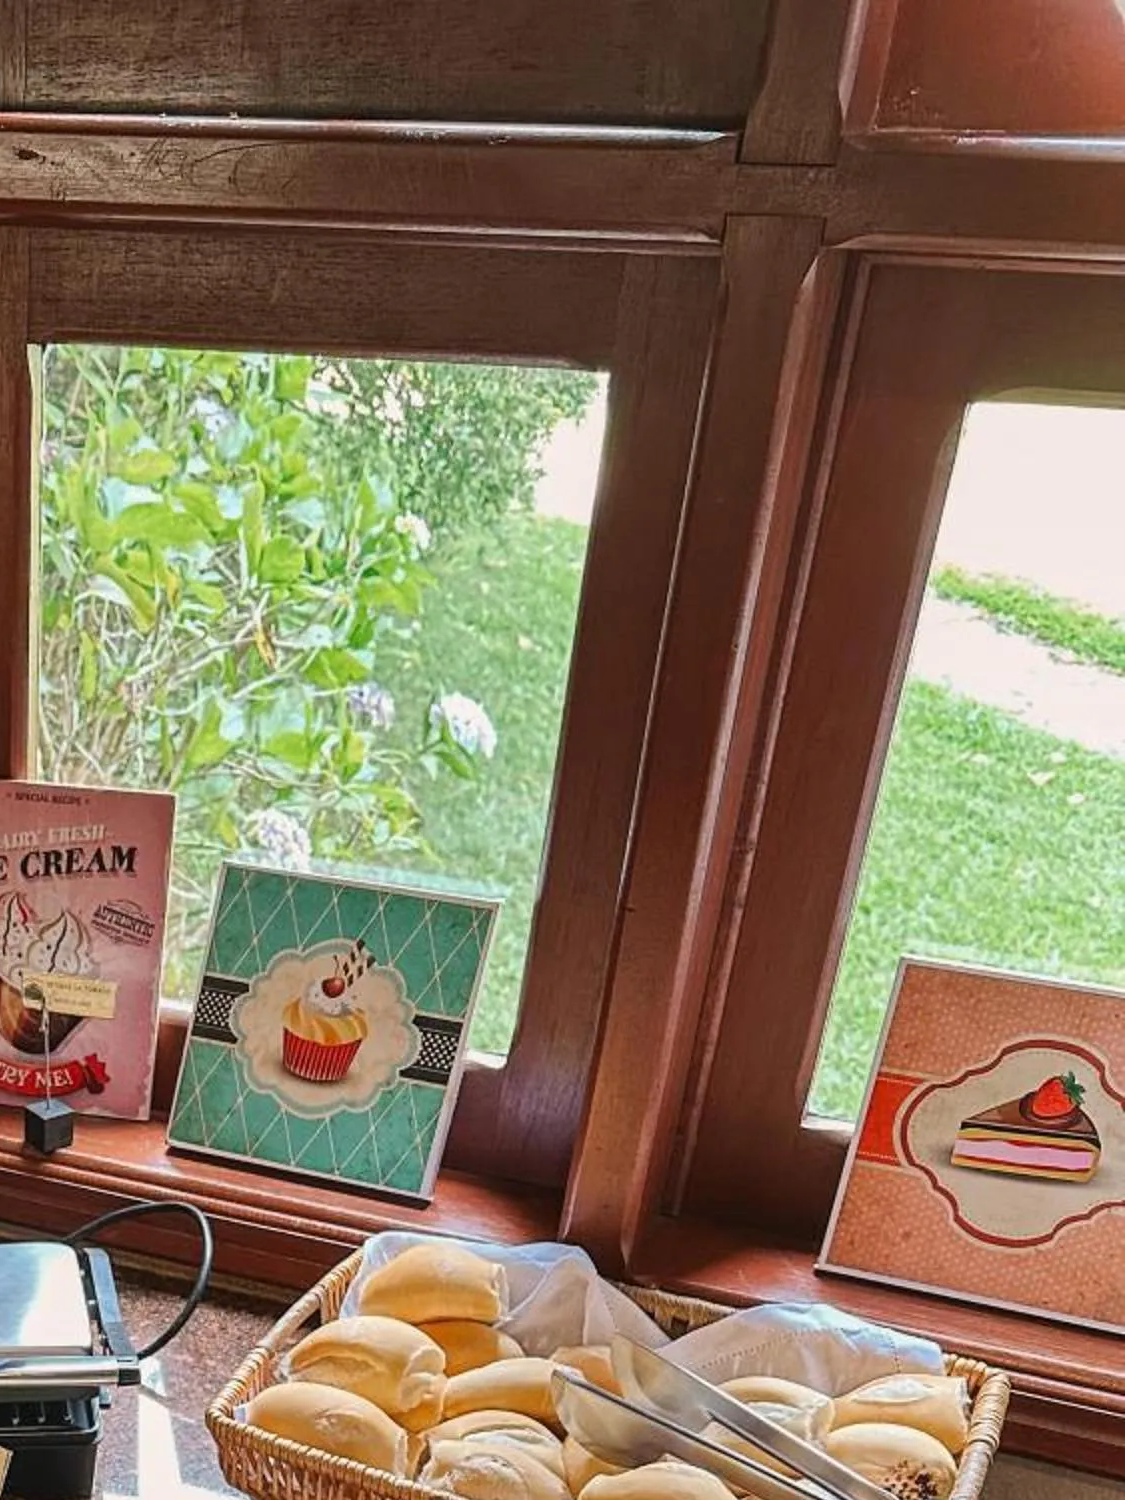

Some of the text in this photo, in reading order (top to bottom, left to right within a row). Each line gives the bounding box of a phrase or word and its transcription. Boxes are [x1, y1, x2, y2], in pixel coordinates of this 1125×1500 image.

[48, 824, 106, 844] FRESH
[20, 845, 138, 880] CREAM
[35, 1068, 74, 1089] ME!
